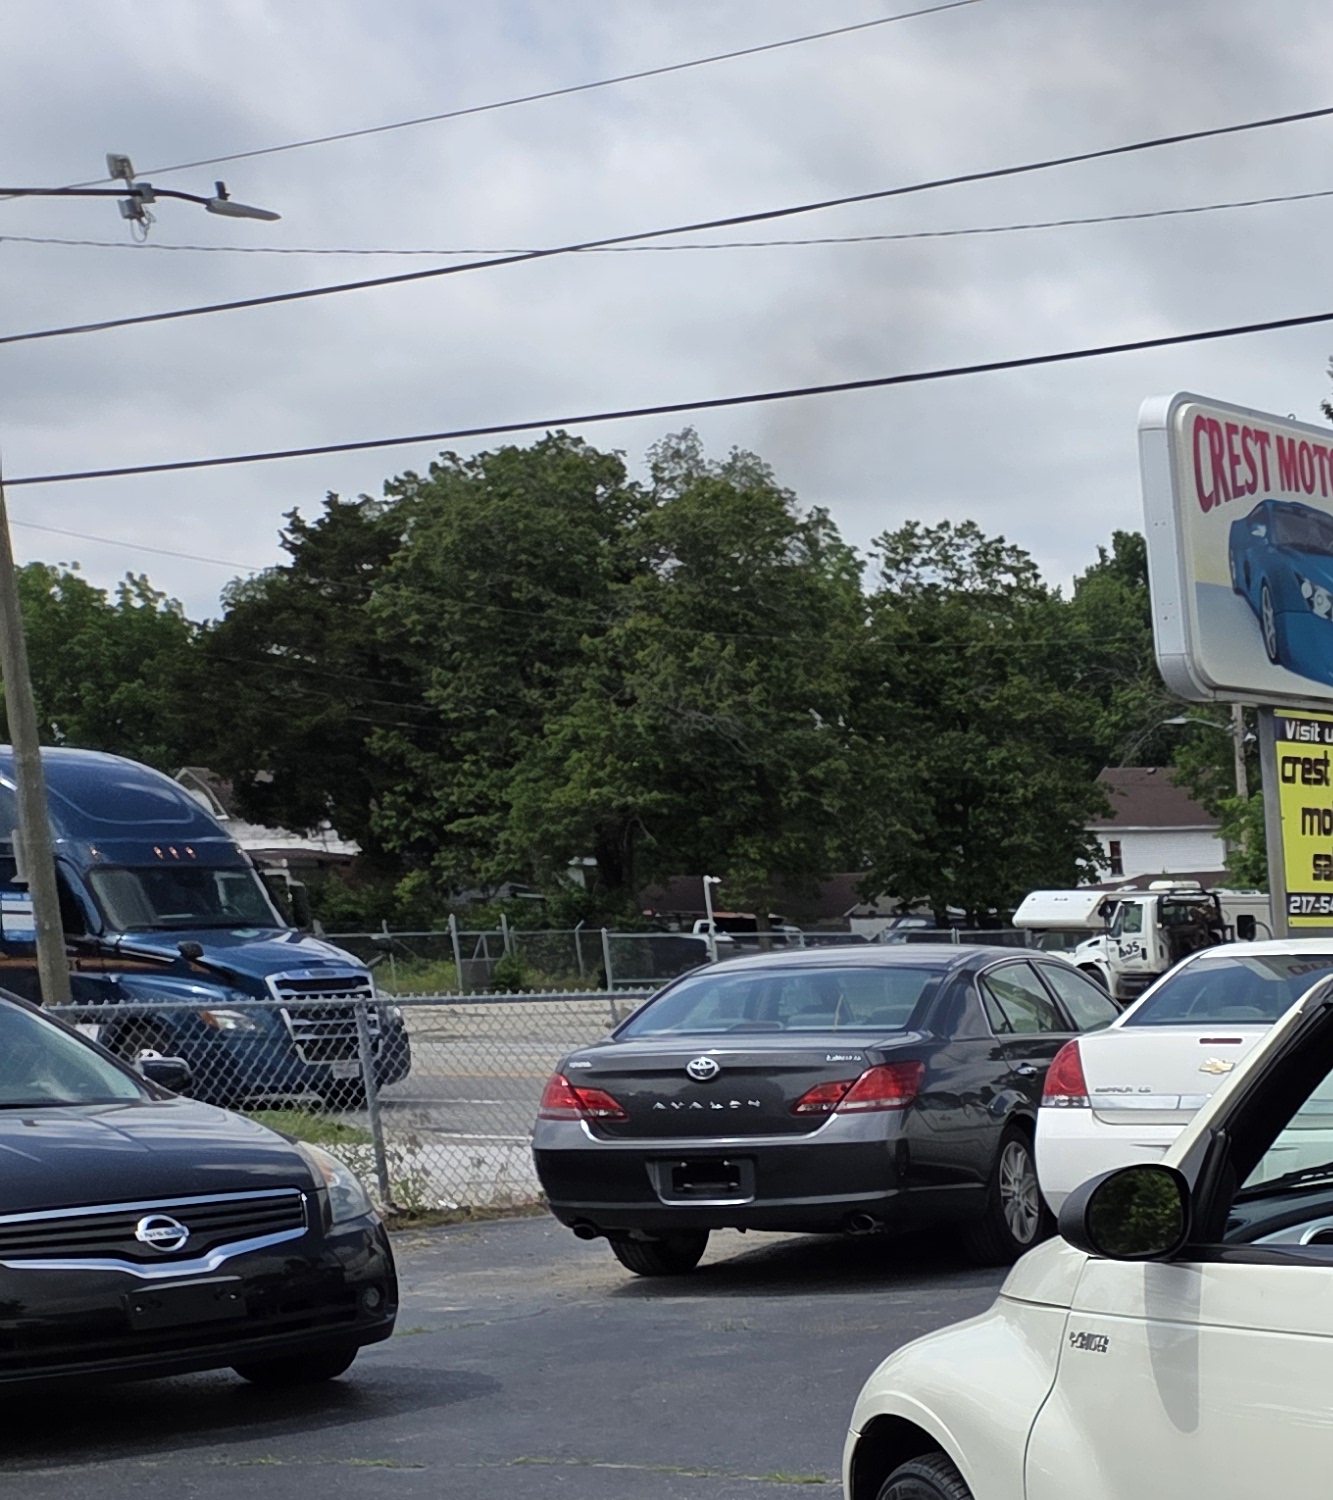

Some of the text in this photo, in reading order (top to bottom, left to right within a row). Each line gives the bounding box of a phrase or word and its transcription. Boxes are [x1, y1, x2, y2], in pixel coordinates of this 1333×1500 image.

[1193, 415, 1271, 513] CREST
[1285, 720, 1320, 741] Visit
[1281, 750, 1330, 787] crest
[652, 1099, 761, 1110] AVALON
